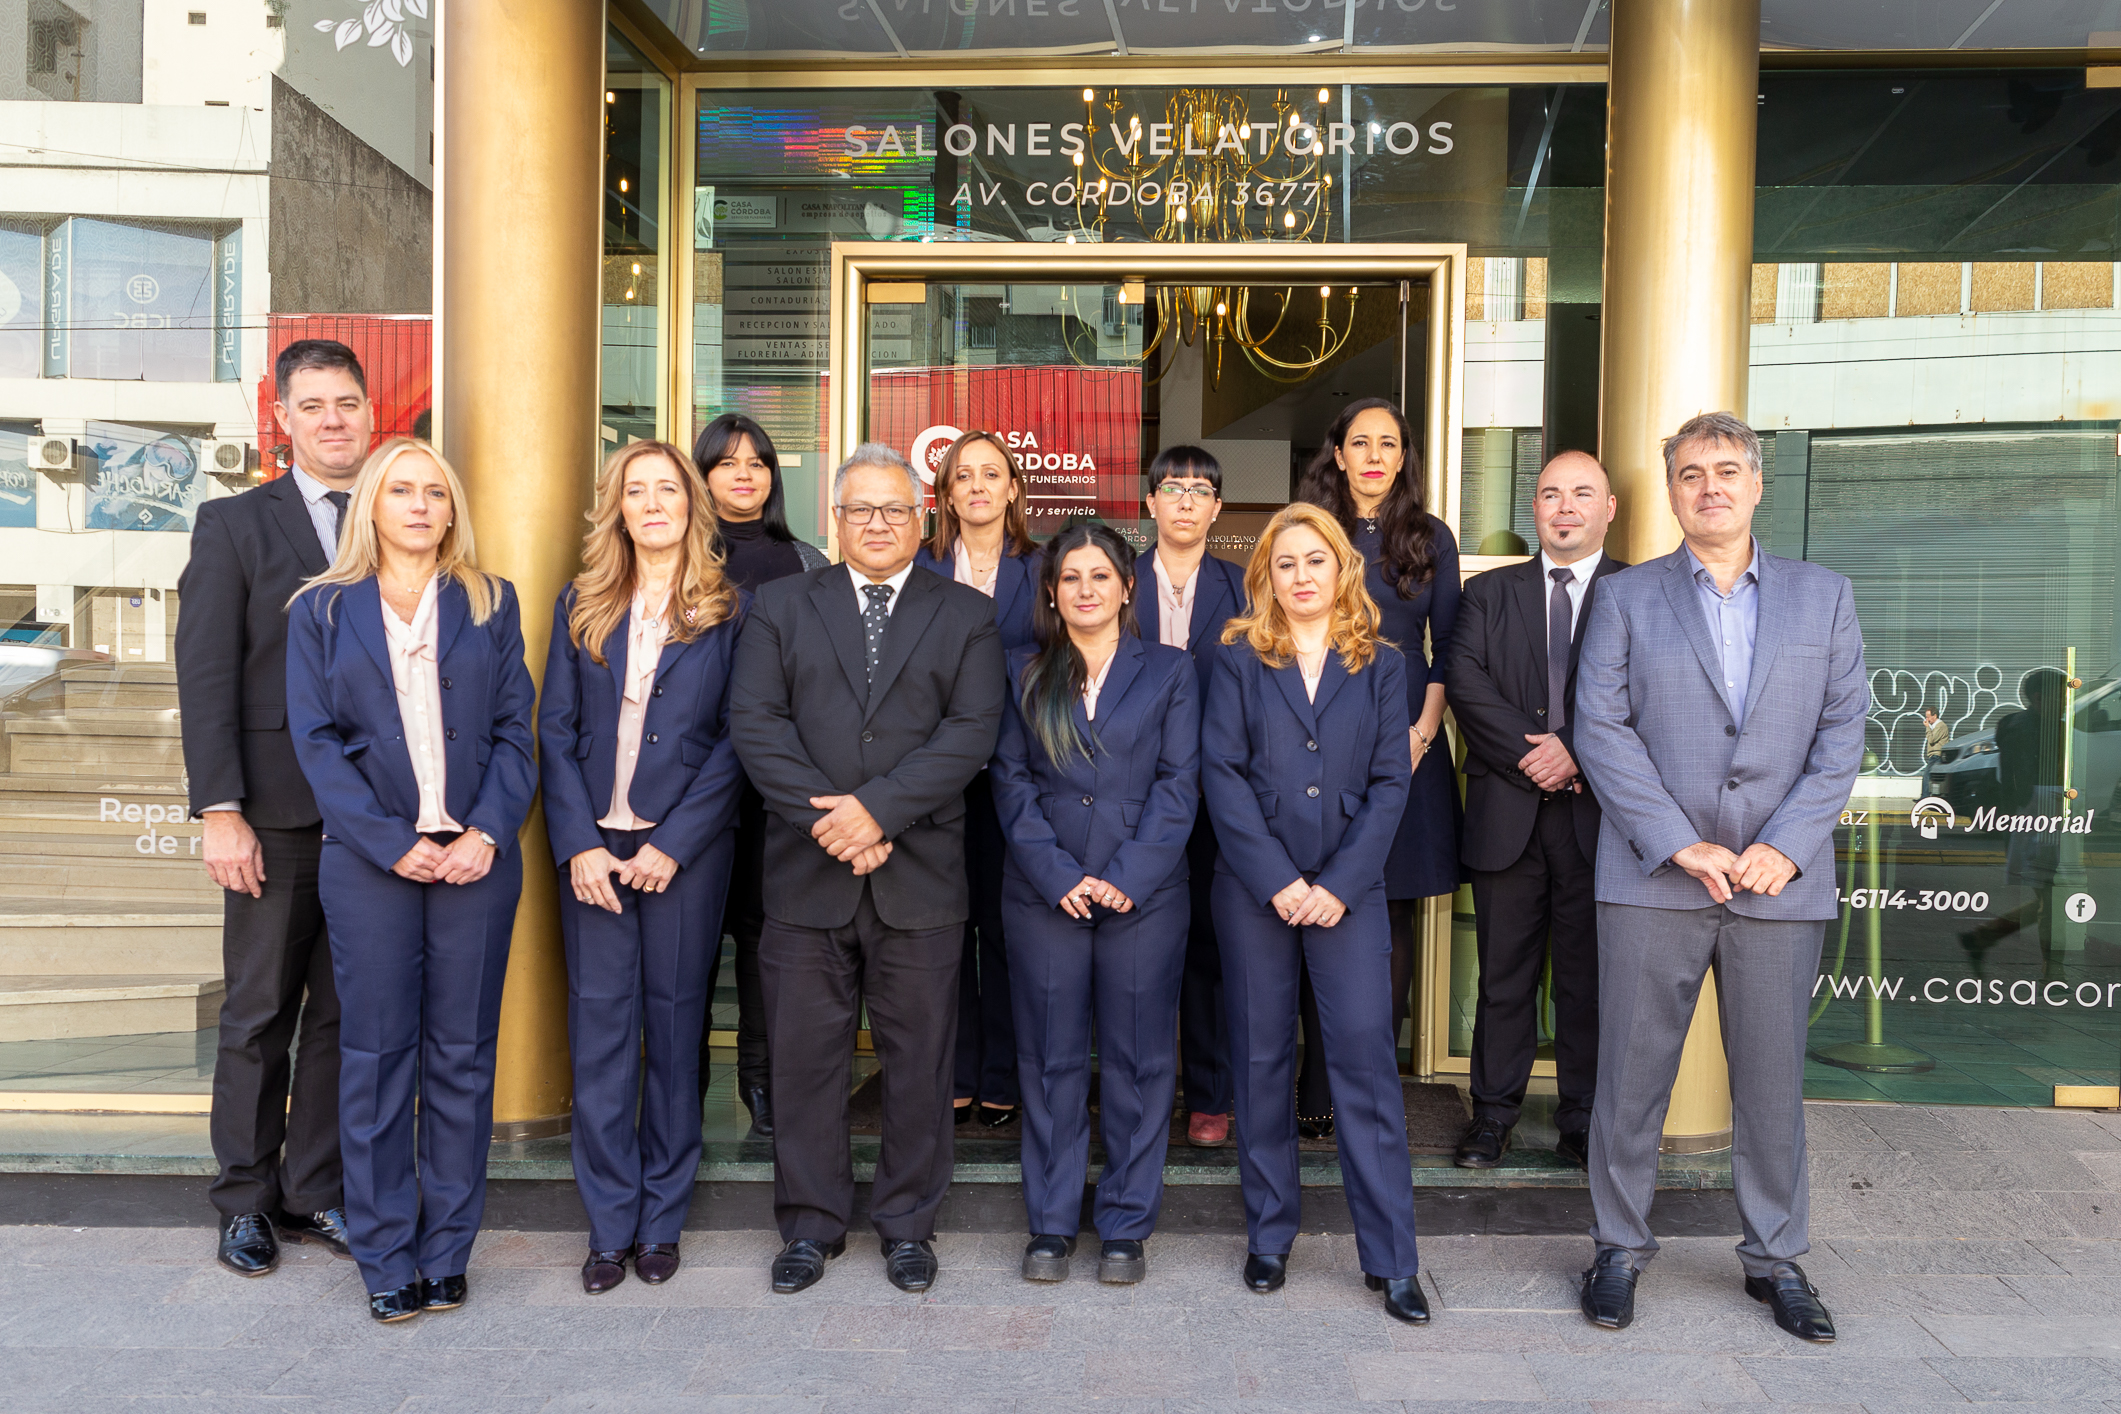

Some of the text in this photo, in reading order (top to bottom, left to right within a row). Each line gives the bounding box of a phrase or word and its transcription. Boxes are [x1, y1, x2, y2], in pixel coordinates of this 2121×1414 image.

[843, 121, 1455, 157] SALONES VELATORIOS
[950, 175, 1323, 207] AV. CÓRDOBA 3677
[730, 207, 771, 215] CÓRDOBA
[801, 203, 822, 211] CASA
[767, 267, 801, 275] SALON
[776, 276, 811, 284] SALON
[750, 296, 821, 304] CONTADURIA
[739, 321, 799, 329] RECEPCION
[766, 341, 807, 349] VENTAS
[738, 350, 790, 358] FLORERIA
[1012, 453, 1096, 471] RDOBA
[1030, 475, 1096, 484] FUNERARIOS
[1047, 506, 1096, 516] servicio
[1840, 805, 2095, 835] az Memorial
[135, 829, 178, 855] de
